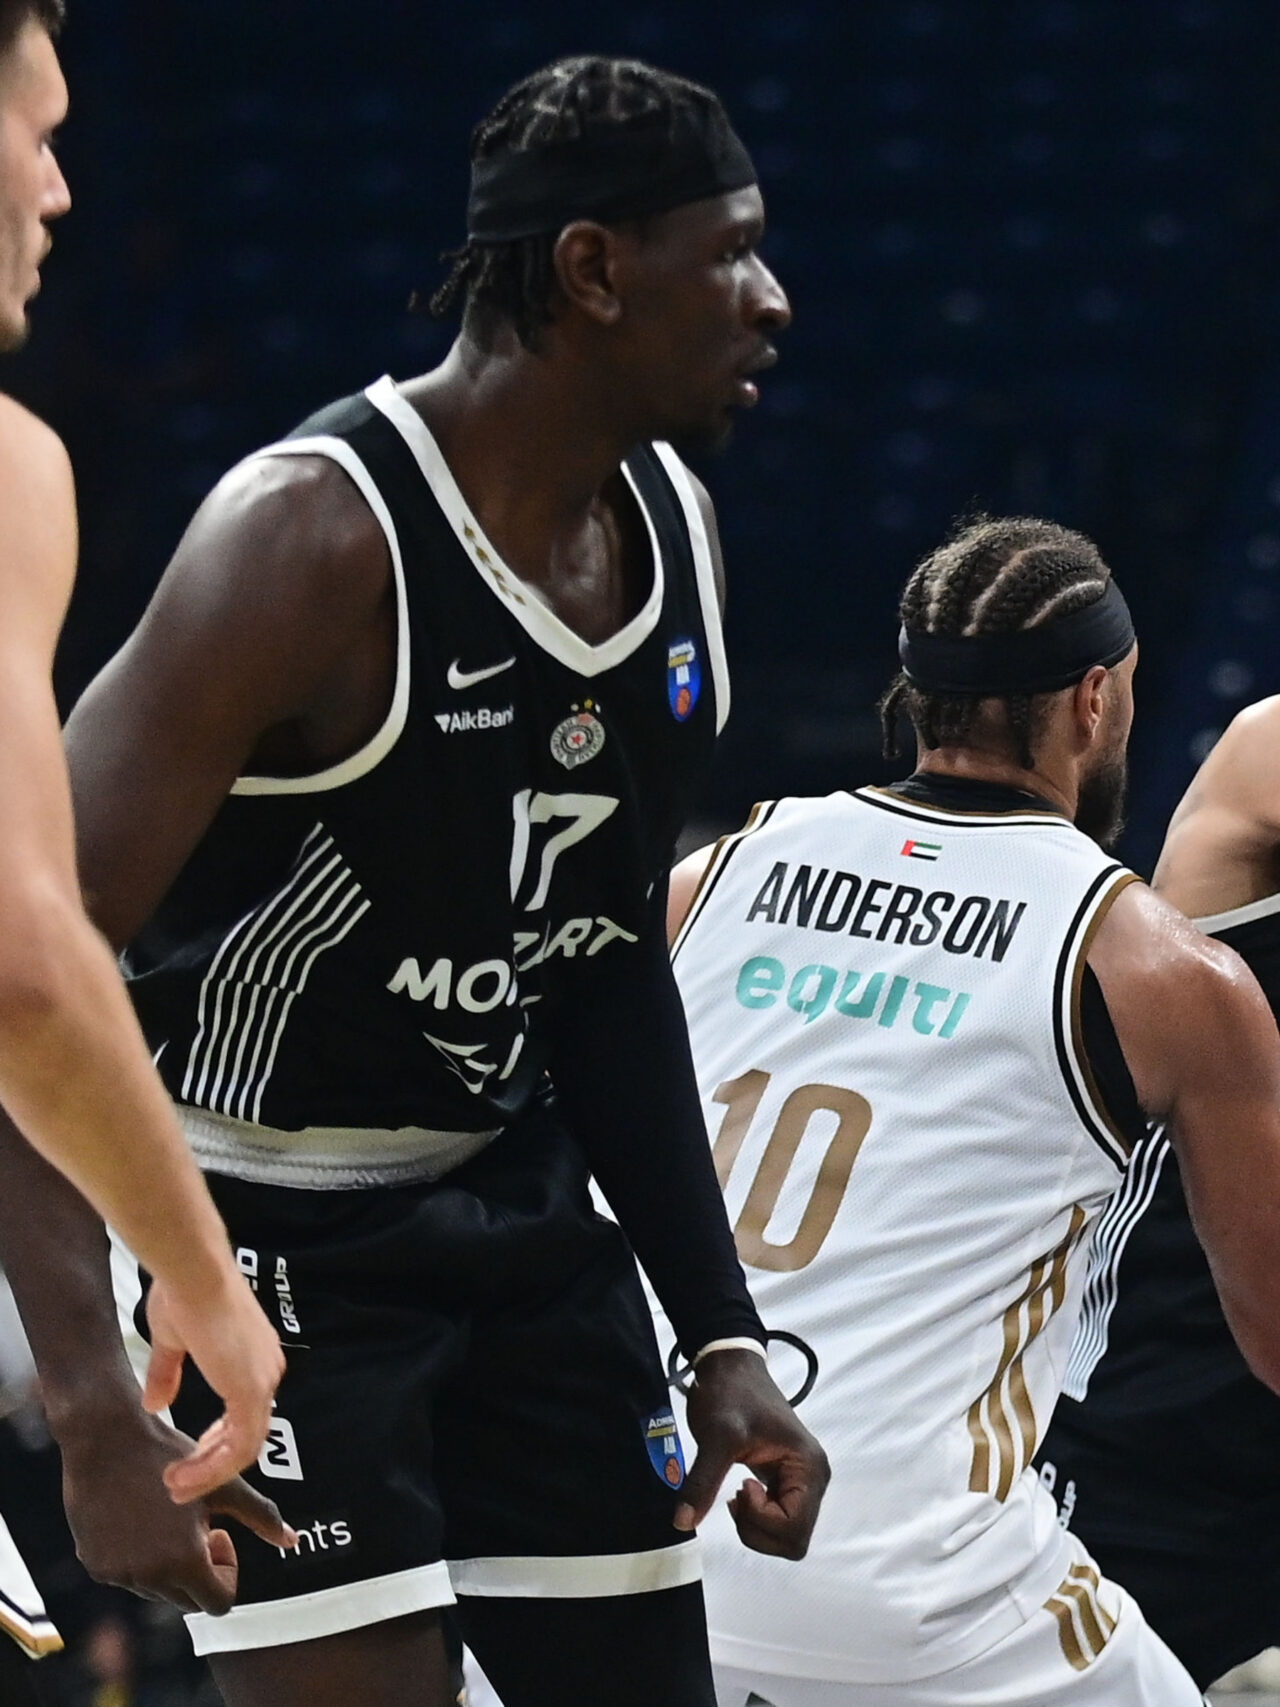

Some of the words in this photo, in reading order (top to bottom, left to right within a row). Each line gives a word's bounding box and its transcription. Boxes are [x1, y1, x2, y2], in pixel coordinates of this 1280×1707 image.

[450, 704, 514, 733] AikBan
[510, 788, 620, 912] 17
[746, 861, 1028, 963] ANDERSON
[712, 1069, 873, 1273] 10
